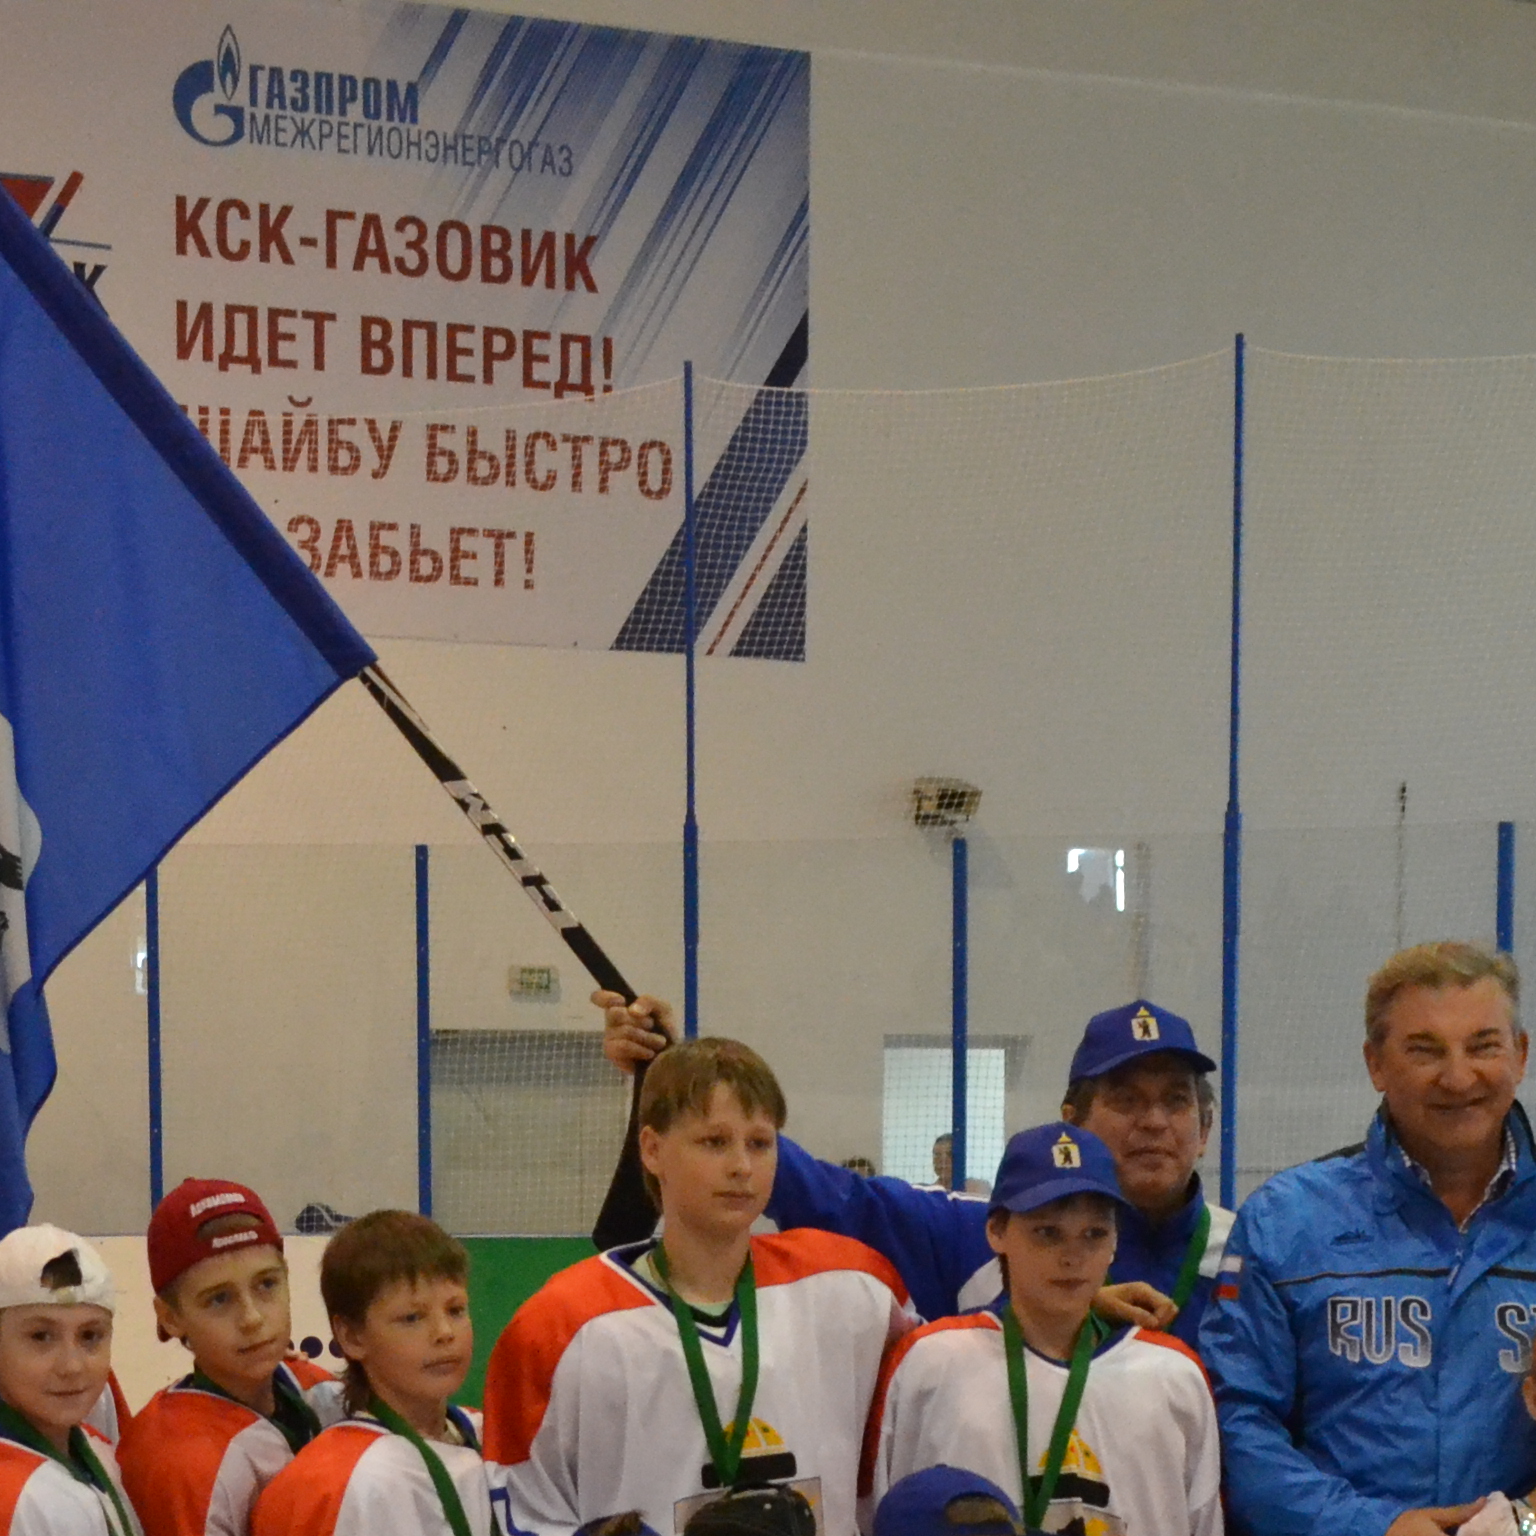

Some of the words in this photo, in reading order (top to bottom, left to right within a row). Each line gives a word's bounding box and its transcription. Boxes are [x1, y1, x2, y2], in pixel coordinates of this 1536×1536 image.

[248, 63, 420, 126] ГАЗПРОМ
[247, 117, 575, 178] МЕЖРЕГИОНЭНЕРГОГАЗ
[174, 194, 600, 294] КСК-ГАЗОВИК
[174, 298, 338, 376] ИДЕТ
[360, 314, 615, 403] ВПЕРЕД!
[425, 422, 674, 501] БЫСТРО
[286, 513, 536, 591] ЗАБЬЕТ!
[1327, 1296, 1433, 1369] RUS
